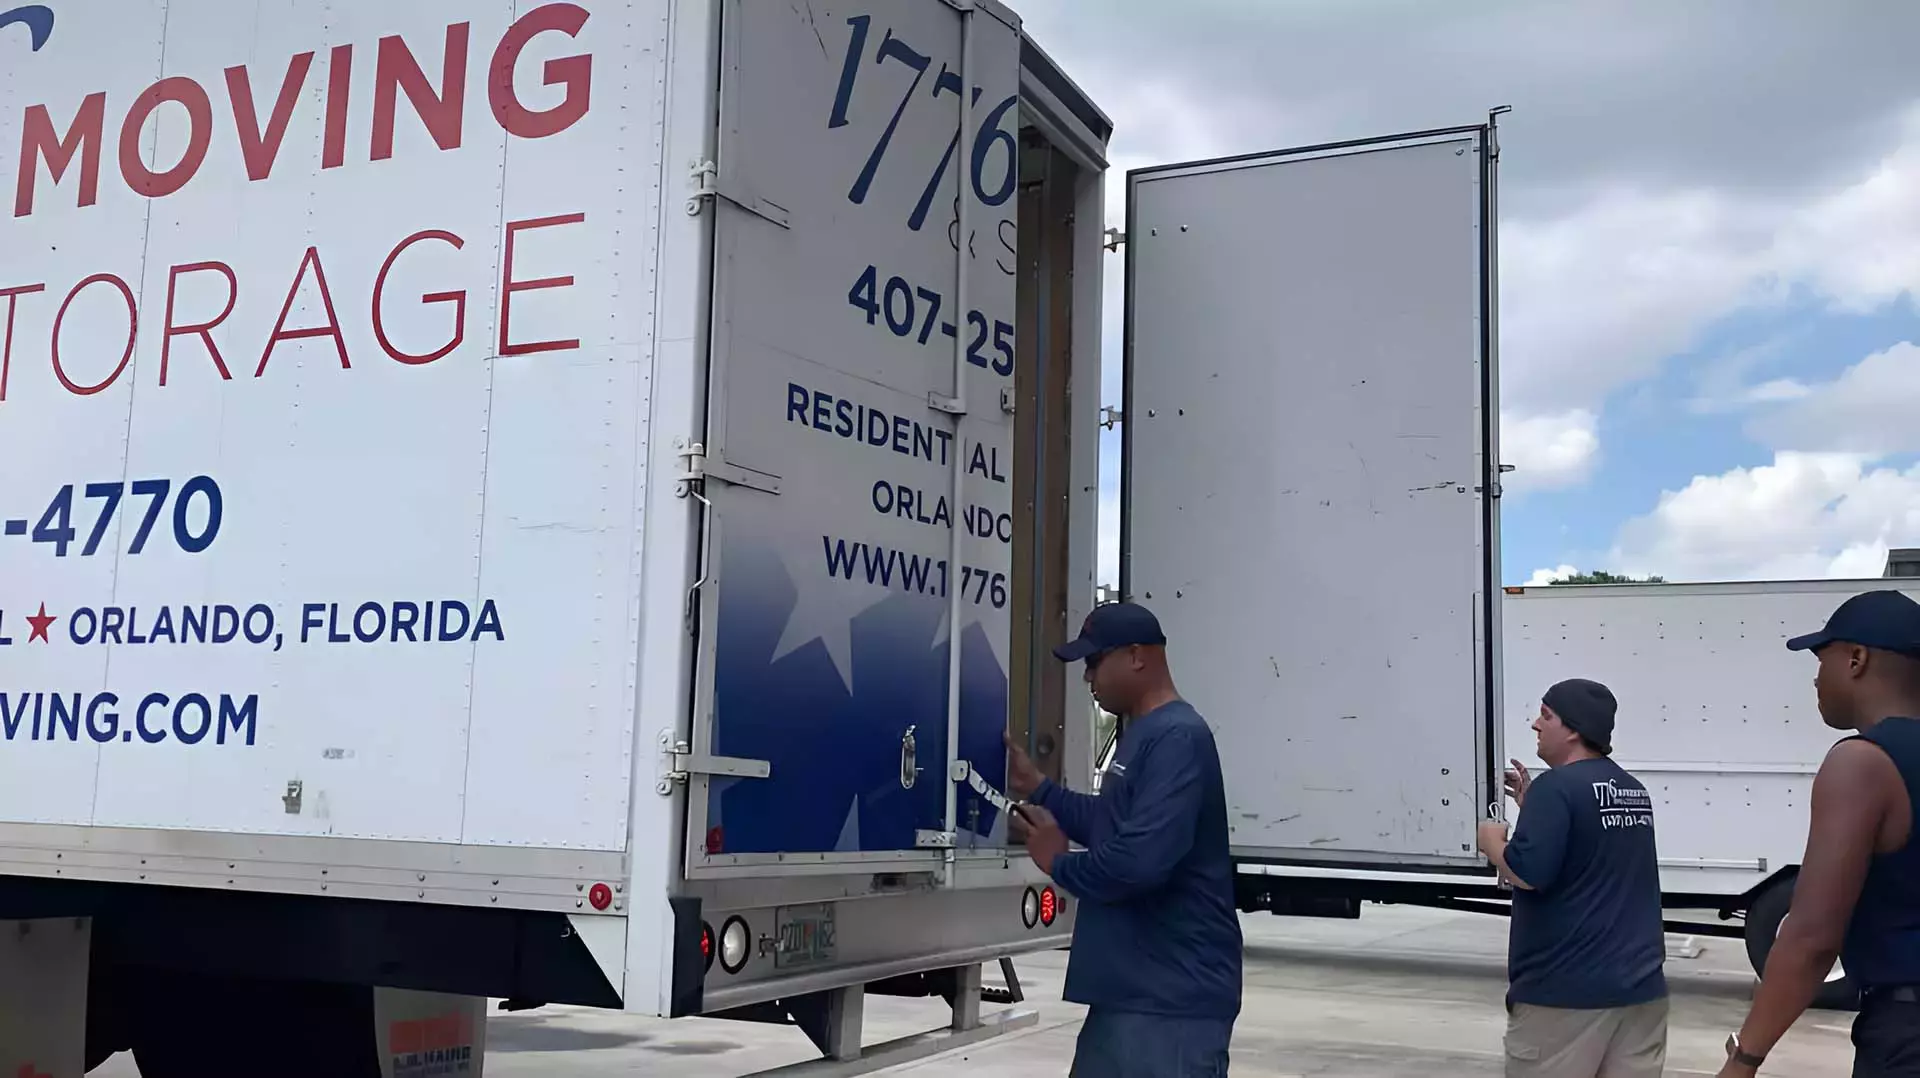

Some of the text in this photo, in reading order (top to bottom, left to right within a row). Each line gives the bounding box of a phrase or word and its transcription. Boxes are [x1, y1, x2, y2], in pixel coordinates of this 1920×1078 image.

[15, 3, 592, 217] MOVING
[828, 15, 1016, 232] 1776
[0, 212, 585, 400] TORAGE
[848, 264, 1014, 377] 407-25
[4, 475, 223, 557] -4770
[823, 535, 1007, 609] WWW.1776
[69, 603, 284, 651] ORLANDO,
[300, 600, 505, 643] FLORIDA
[0, 692, 258, 746] VING.COM
